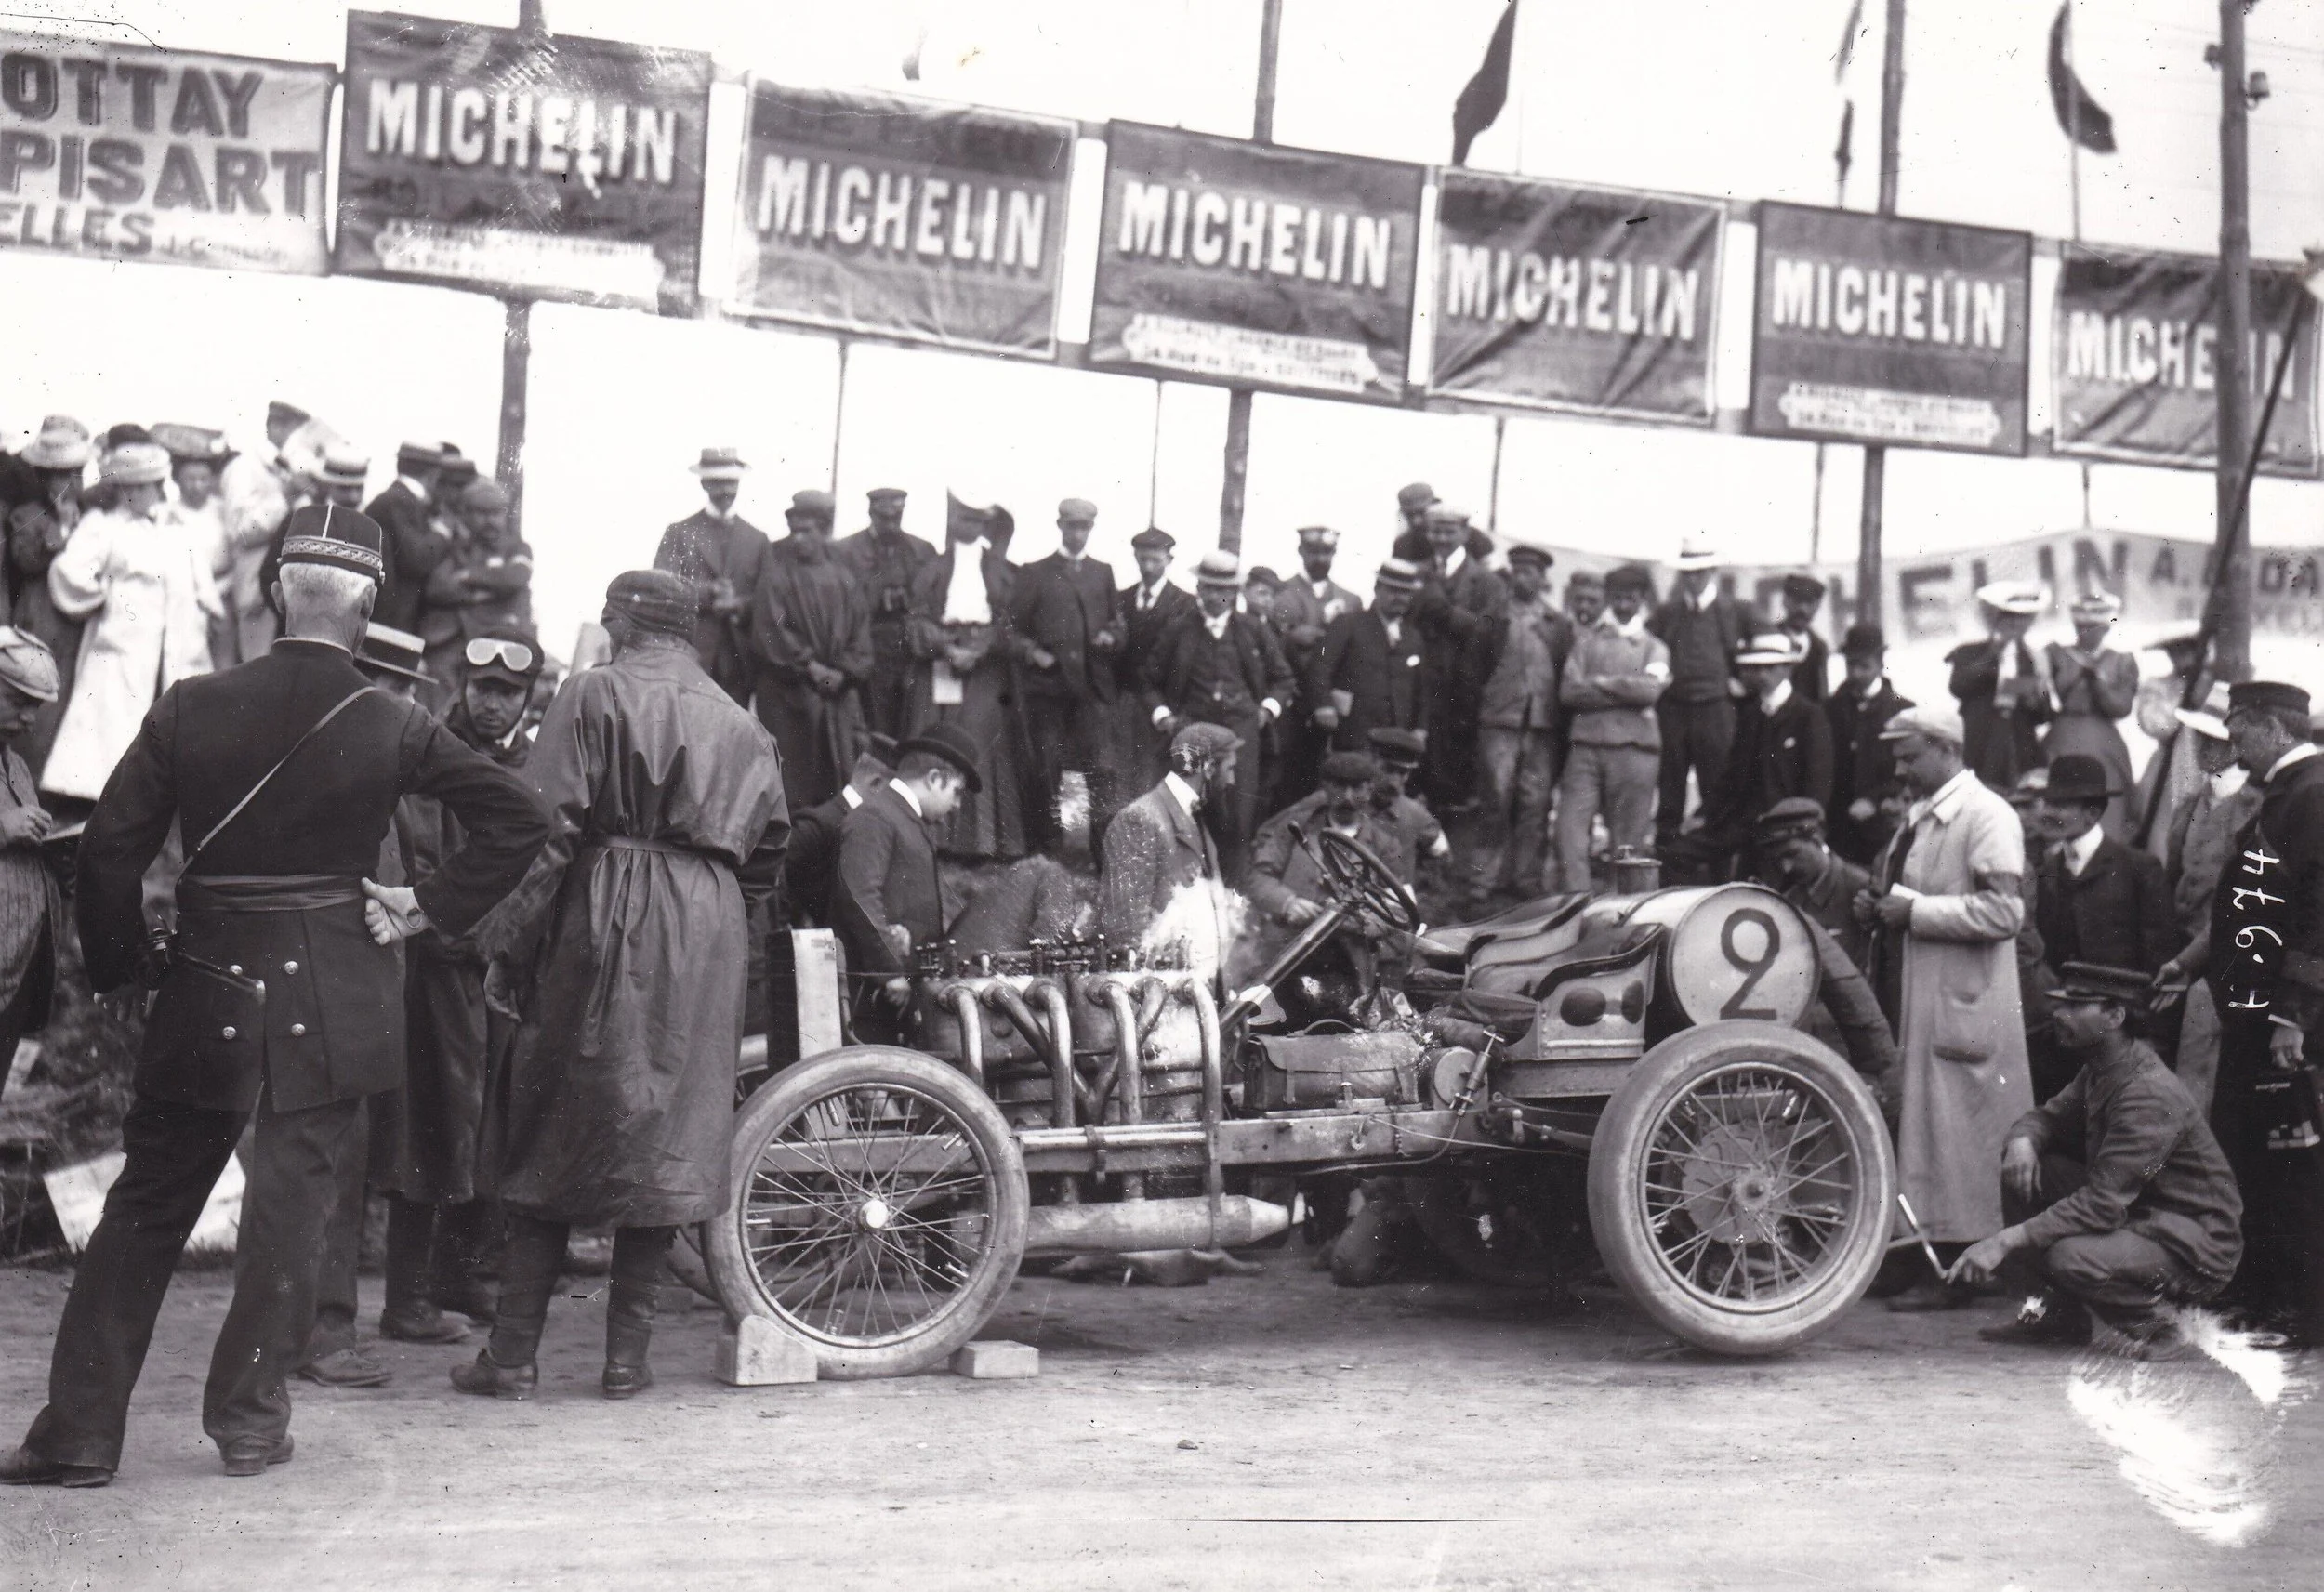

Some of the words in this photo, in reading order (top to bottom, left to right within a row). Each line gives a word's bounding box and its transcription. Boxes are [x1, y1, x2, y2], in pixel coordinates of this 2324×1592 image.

[0, 127, 320, 215] PISART
[366, 78, 676, 184] MICHELIN
[756, 154, 1046, 269] MICHELIN
[1118, 180, 1391, 289] MICHELIN
[1446, 243, 1698, 341] MICHELIN
[1773, 257, 2006, 349] MICHELIN
[2067, 310, 2296, 401] MICHEIN
[1720, 907, 1781, 1021] 2
